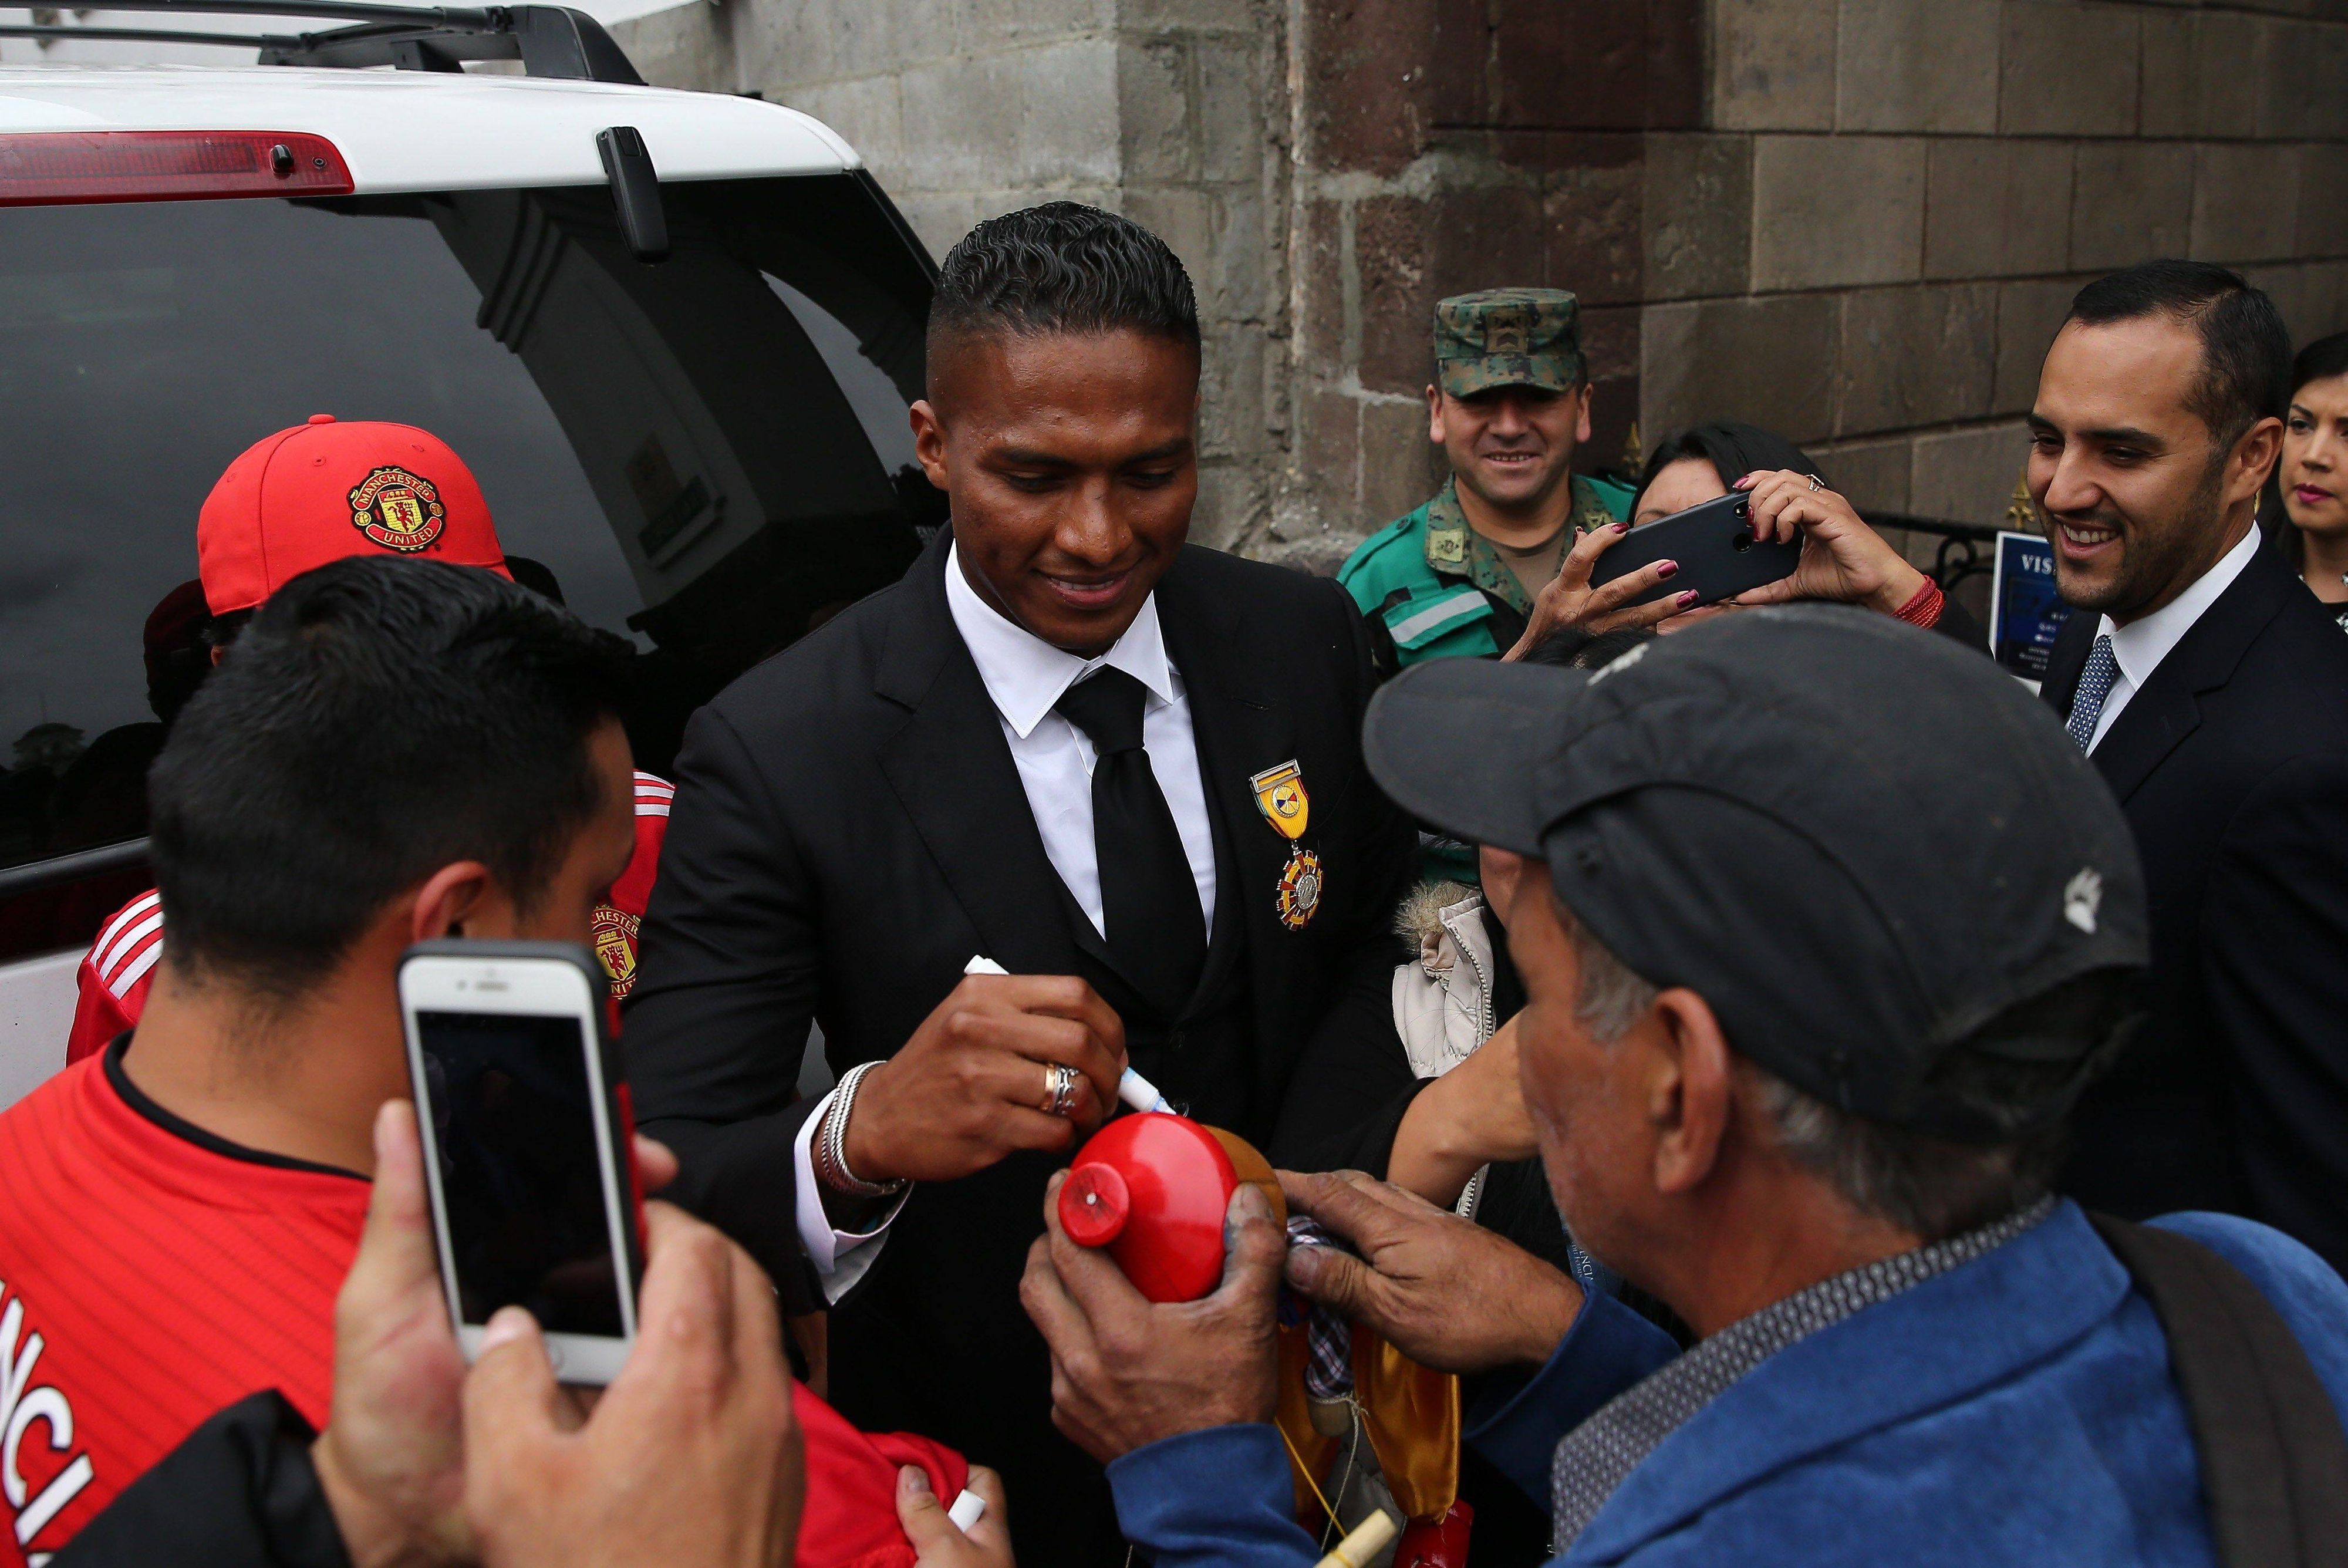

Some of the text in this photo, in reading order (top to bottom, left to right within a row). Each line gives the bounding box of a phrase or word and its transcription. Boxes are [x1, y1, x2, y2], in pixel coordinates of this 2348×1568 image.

[359, 473, 430, 504] MANCHESTER
[383, 527, 433, 544] UNITED
[2022, 554, 2056, 575] VIS
[611, 978, 636, 993] NIT
[0, 1279, 94, 1568] NCI
